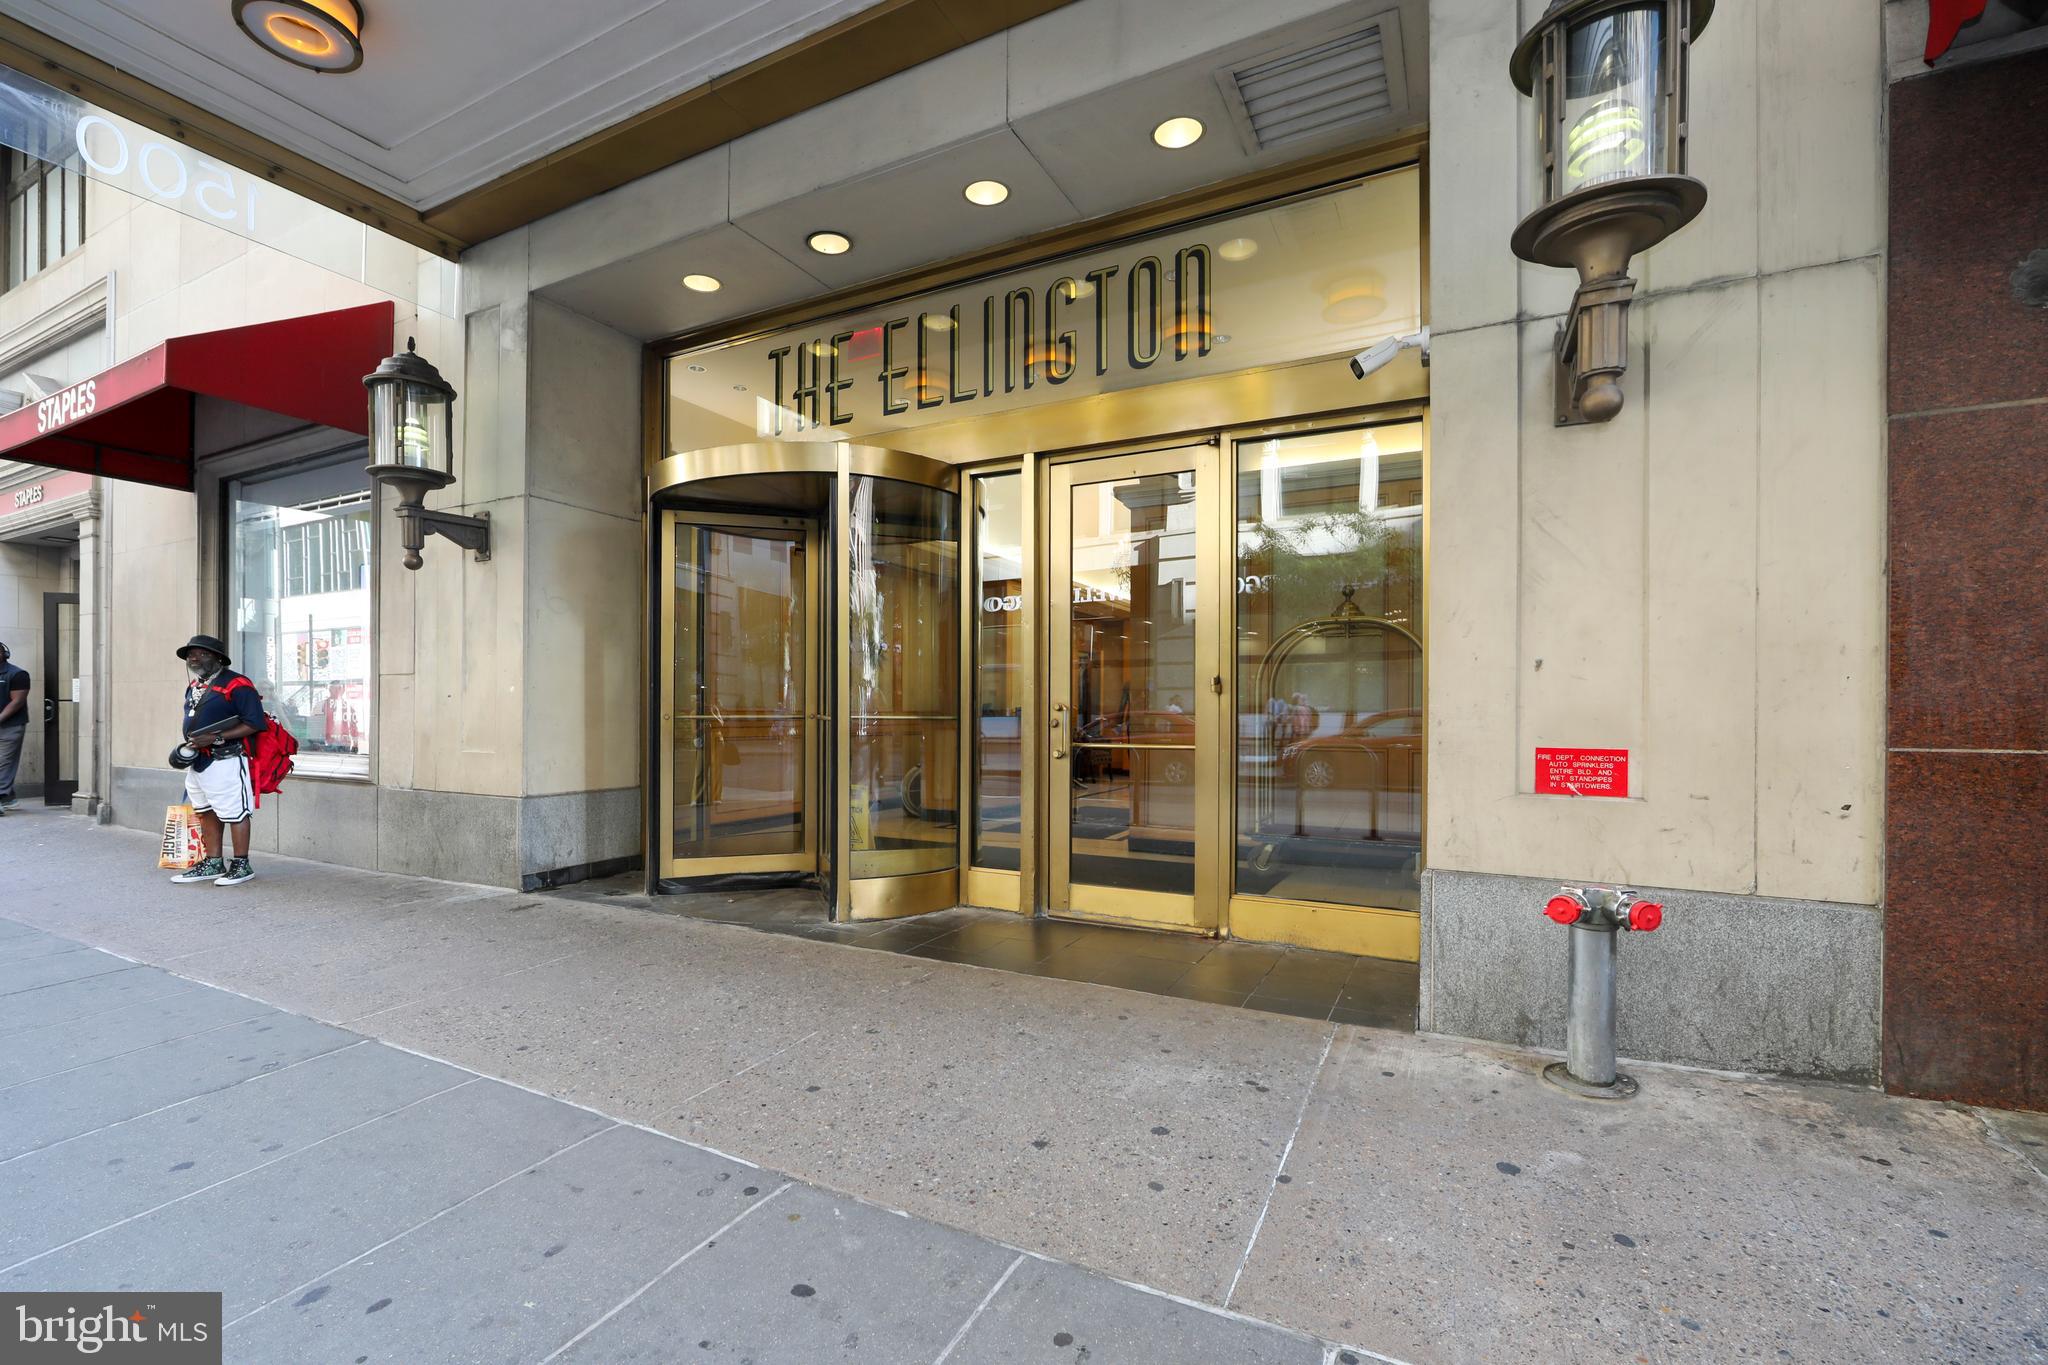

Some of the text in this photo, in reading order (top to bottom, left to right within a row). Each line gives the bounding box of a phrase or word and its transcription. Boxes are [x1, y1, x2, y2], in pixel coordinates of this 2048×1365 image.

[768, 243, 1212, 436] THE ELLINGTON
[37, 380, 96, 433] STAPLES
[15, 485, 43, 508] STAPLES
[162, 819, 176, 858] HOAGIE
